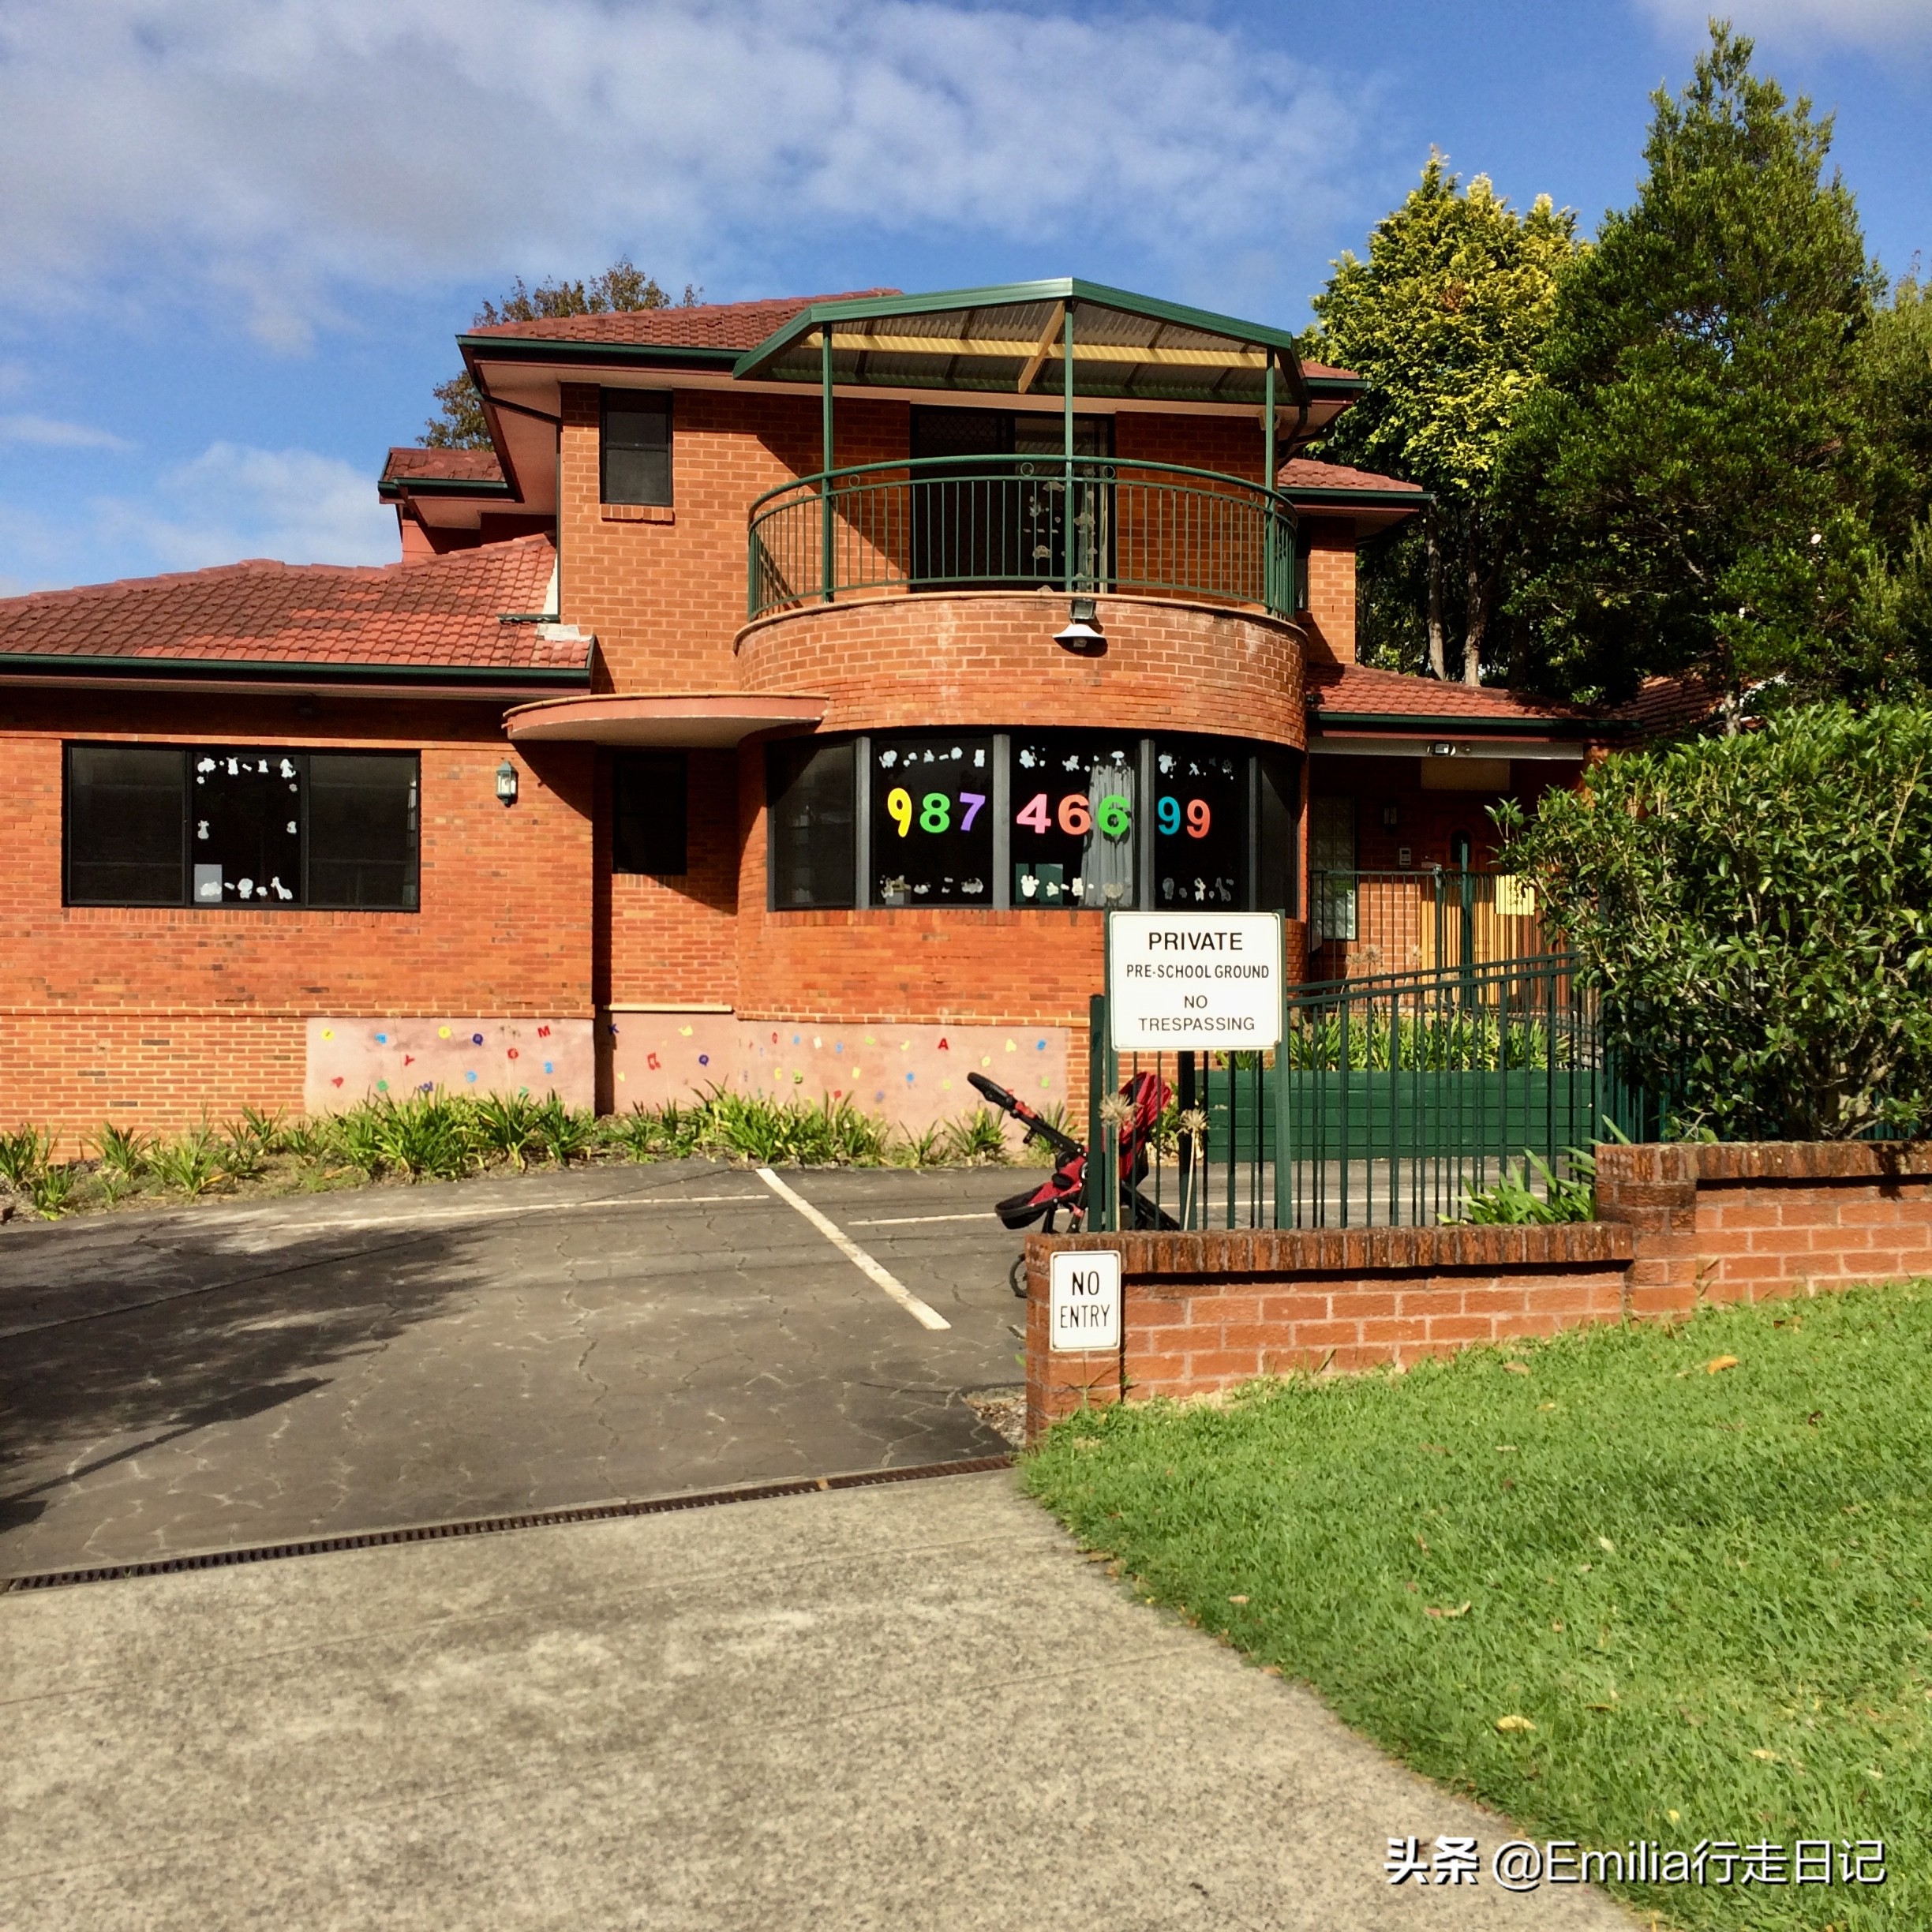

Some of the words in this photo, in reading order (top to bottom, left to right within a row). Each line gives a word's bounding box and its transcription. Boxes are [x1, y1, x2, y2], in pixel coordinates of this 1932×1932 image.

[887, 788, 986, 838] 987
[1016, 793, 1130, 836] 466
[1157, 796, 1211, 839] 99
[1148, 931, 1243, 951] PRIVATE
[1126, 964, 1211, 979] PRE-SCHOOL
[1215, 964, 1270, 979] GROUND
[1183, 995, 1208, 1009] NO
[537, 1025, 552, 1039] M
[1138, 1017, 1255, 1032] TRESPASSING
[938, 1037, 949, 1050] A
[1072, 1271, 1100, 1296] NO
[1060, 1304, 1110, 1329] ENTRY
